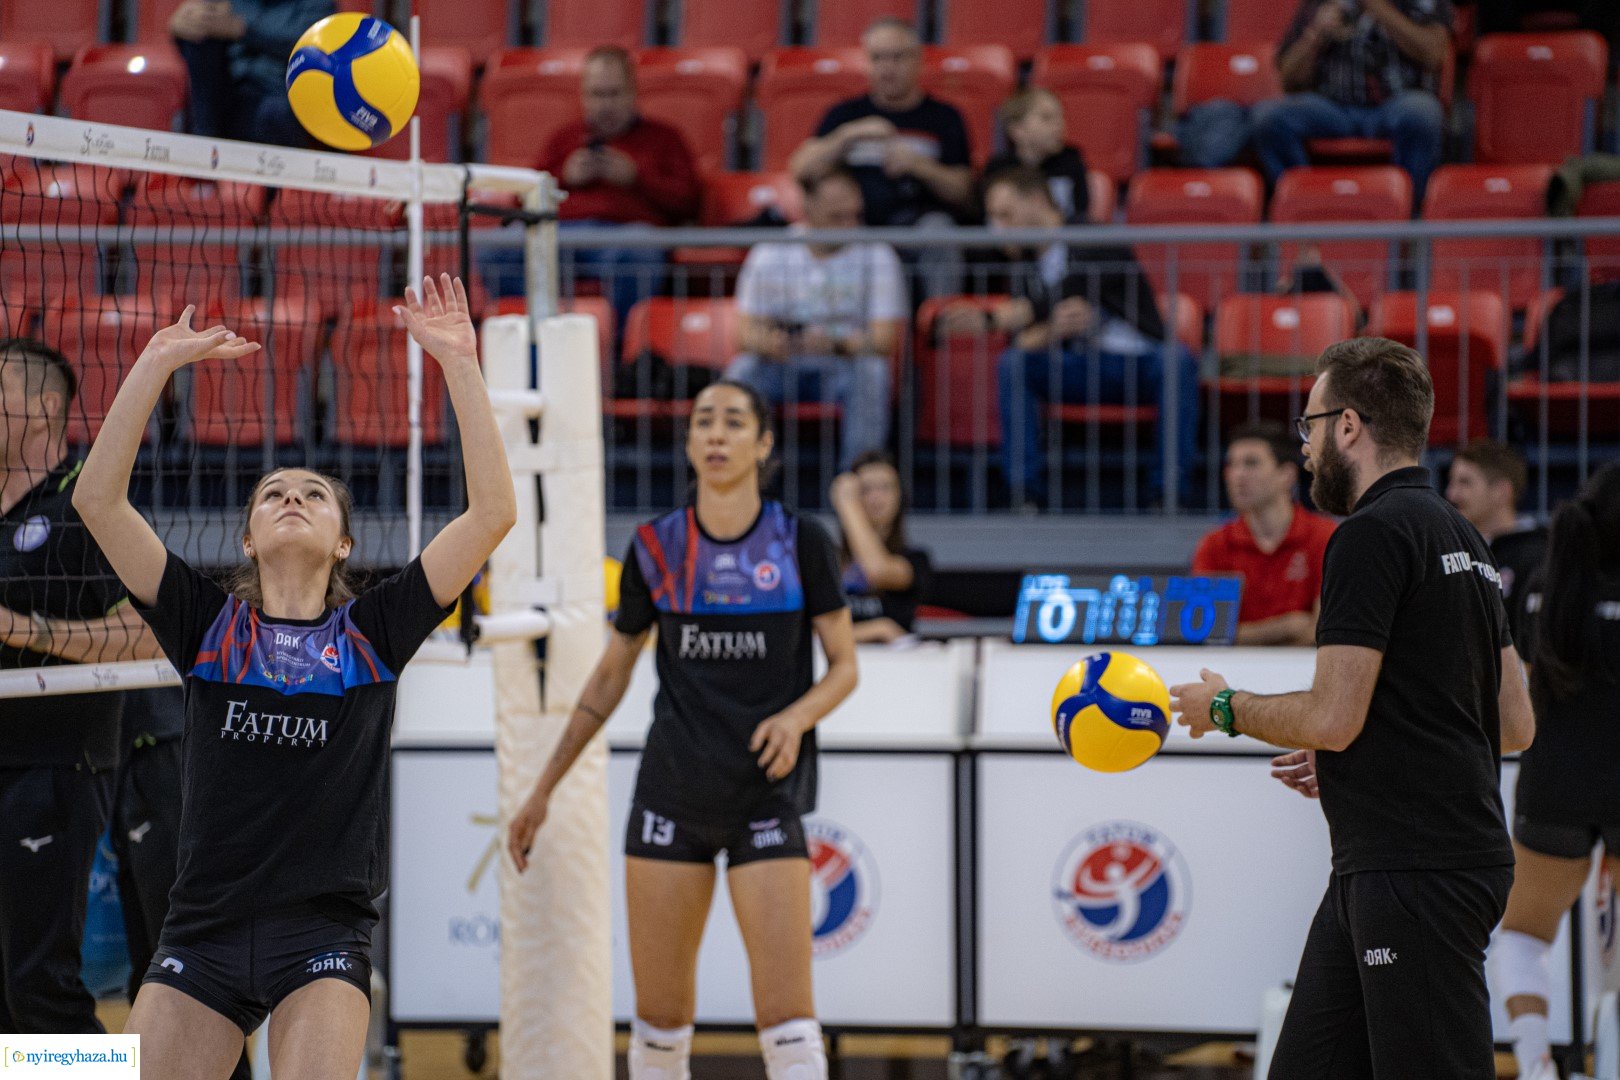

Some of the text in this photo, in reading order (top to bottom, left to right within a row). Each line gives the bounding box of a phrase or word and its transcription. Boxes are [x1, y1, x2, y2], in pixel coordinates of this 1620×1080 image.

[1038, 592, 1077, 642] 0
[681, 623, 766, 651] FATUM
[220, 730, 327, 748] PROPERTY
[221, 699, 328, 741] FATUM
[642, 809, 676, 847] 13
